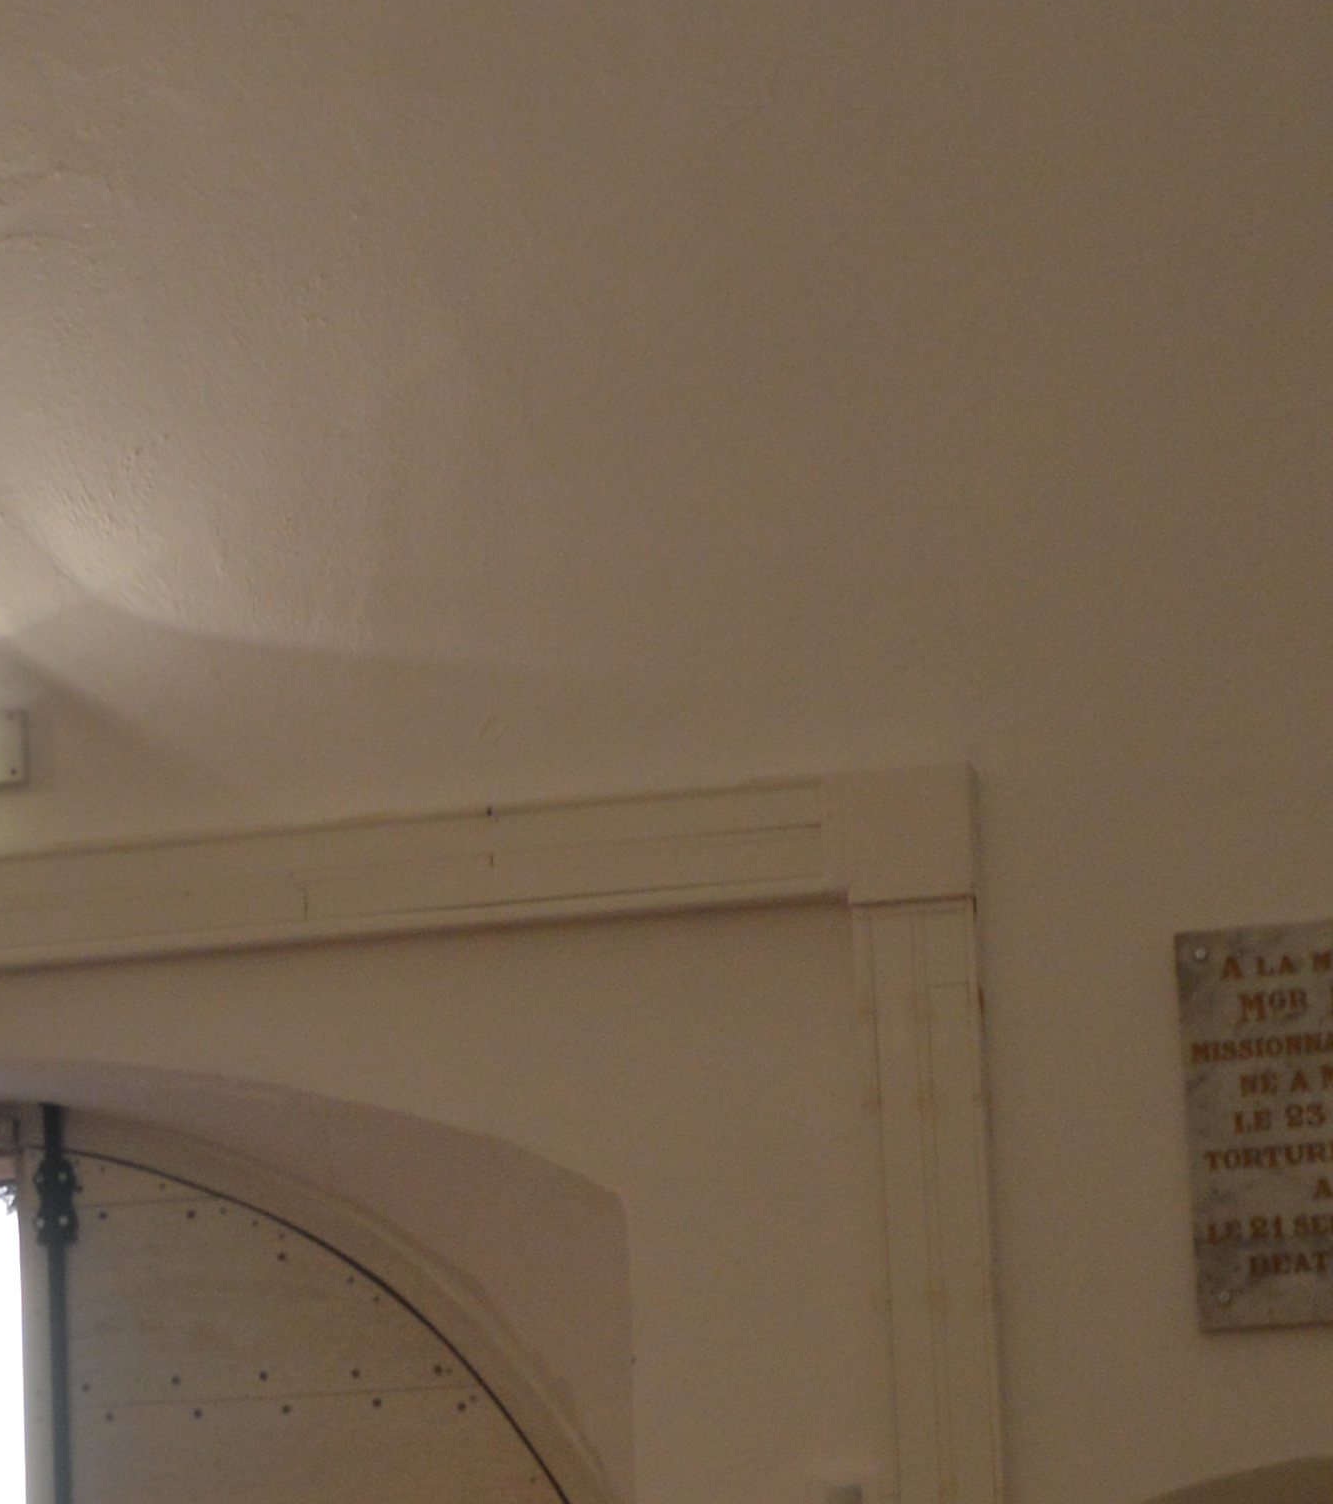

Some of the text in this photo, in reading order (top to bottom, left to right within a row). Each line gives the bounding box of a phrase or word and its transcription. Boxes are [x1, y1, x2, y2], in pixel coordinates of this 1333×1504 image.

[1221, 956, 1244, 980] A
[1256, 955, 1296, 977] LA
[1289, 1069, 1310, 1092] A
[1233, 1103, 1327, 1134] LE 23
[1204, 1140, 1333, 1173] TORTUR
[1249, 1215, 1284, 1241] 21
